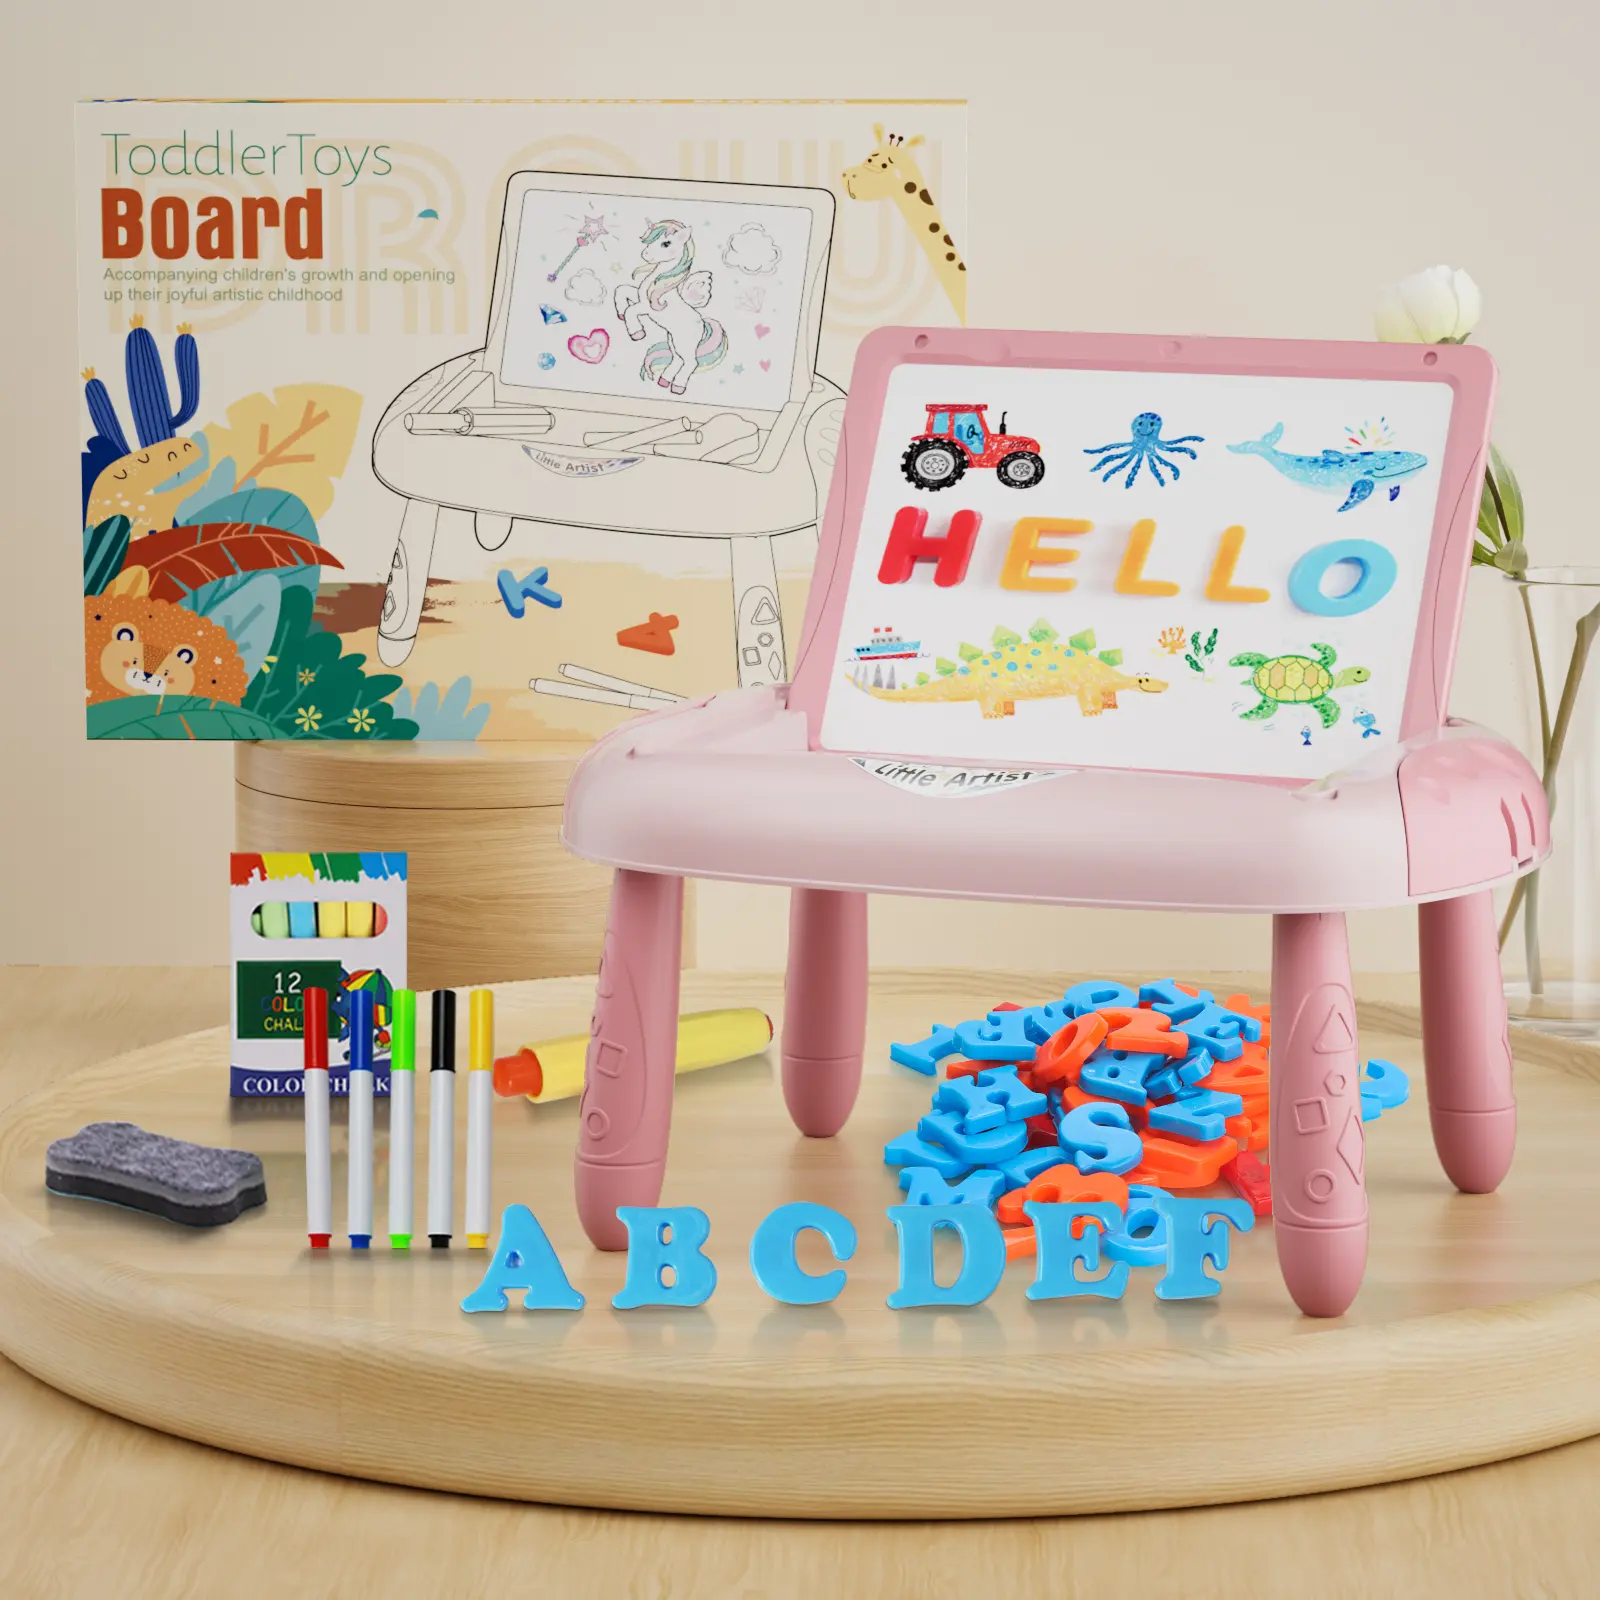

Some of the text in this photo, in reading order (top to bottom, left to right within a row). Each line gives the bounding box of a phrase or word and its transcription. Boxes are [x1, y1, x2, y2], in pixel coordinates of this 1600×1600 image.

[100, 129, 392, 187] ToddlerToys
[101, 188, 323, 260] Board
[103, 268, 455, 284] Accompanying children's growth and opening
[103, 288, 343, 304] up their joyful artistic childhood
[535, 451, 604, 473] Little Artist
[877, 505, 1398, 617] HELLO
[874, 762, 1033, 788] Little Artist
[274, 972, 302, 994] 12
[261, 996, 304, 1012] COLO
[263, 1016, 304, 1032] CHAL
[243, 1076, 306, 1093] COLO
